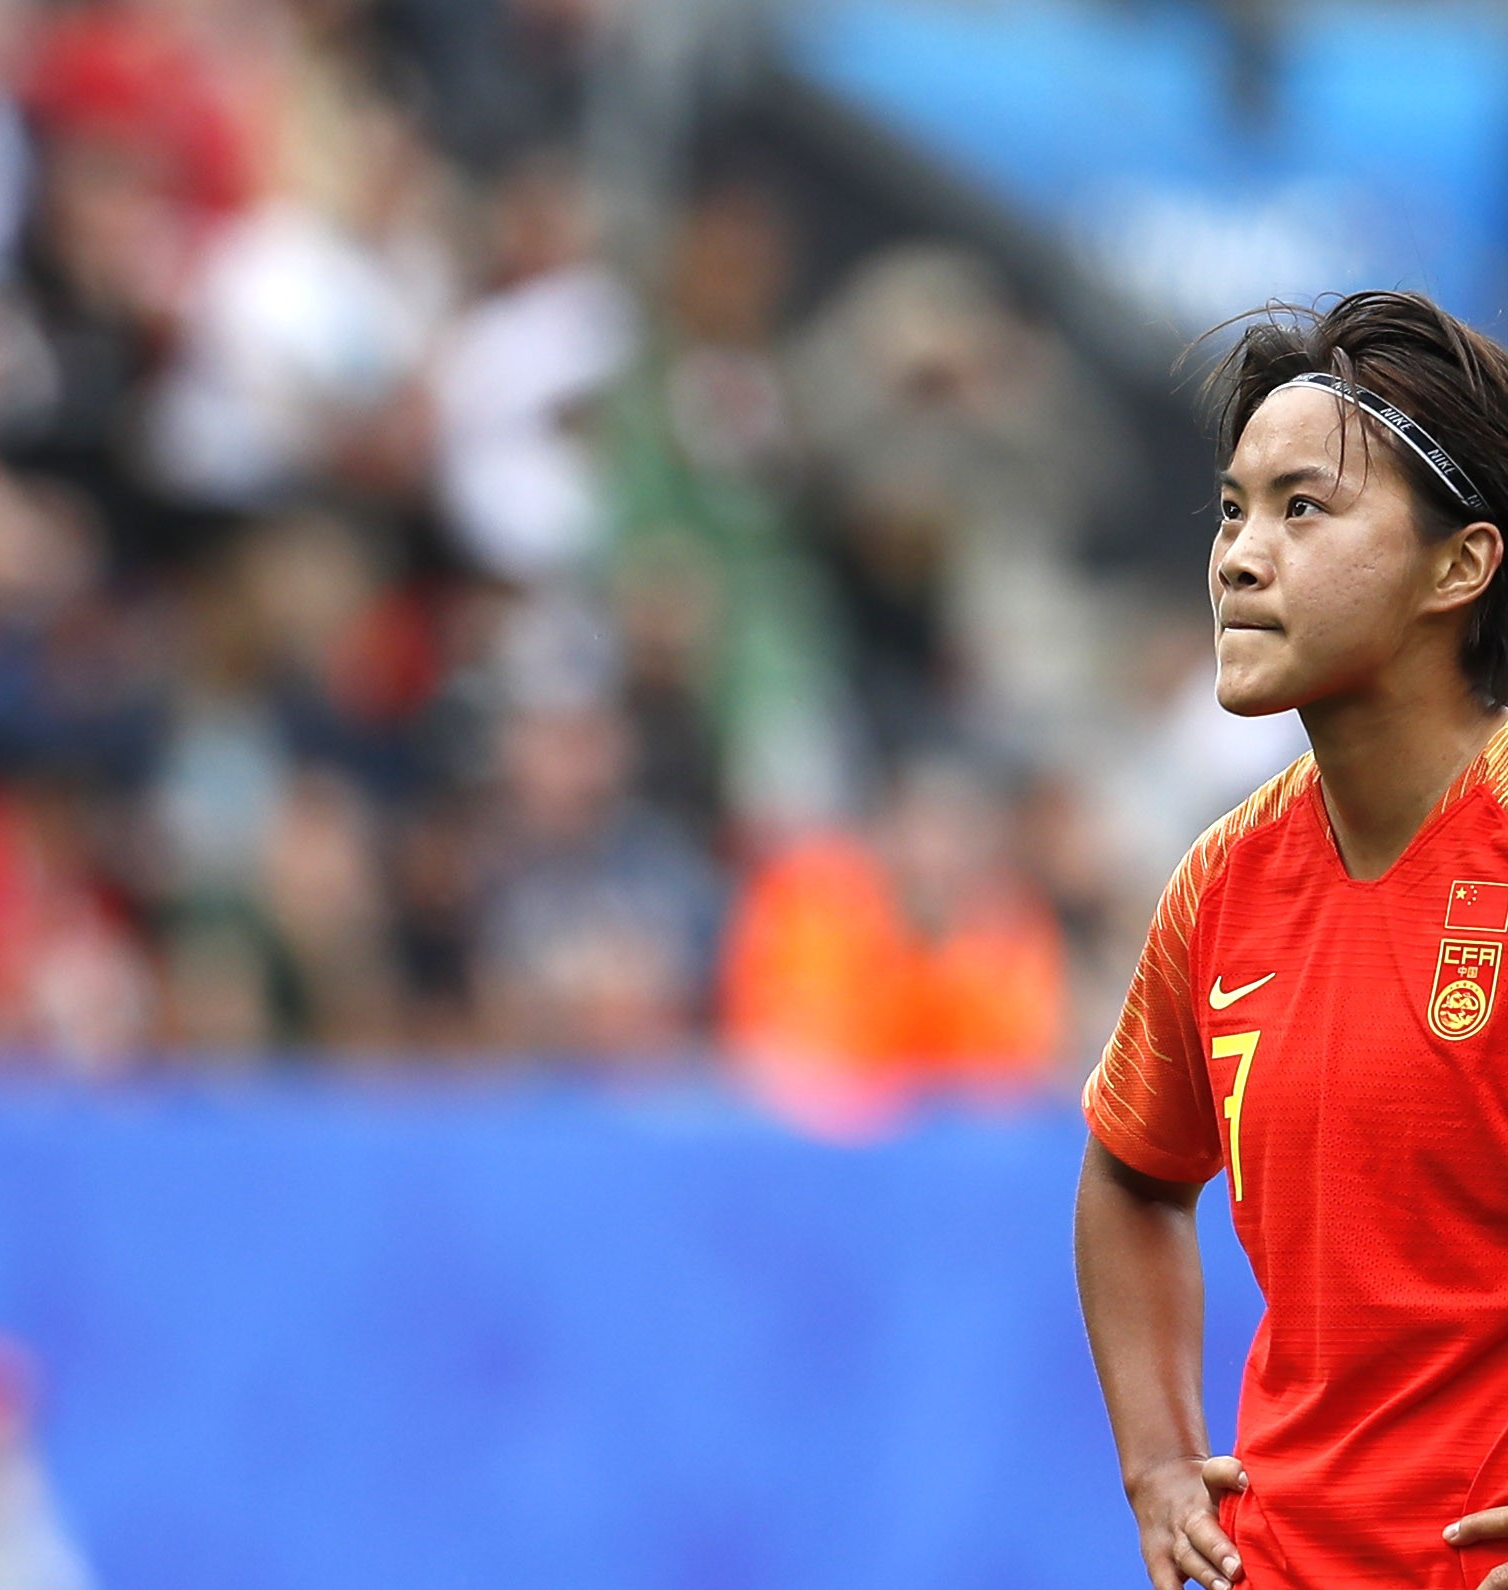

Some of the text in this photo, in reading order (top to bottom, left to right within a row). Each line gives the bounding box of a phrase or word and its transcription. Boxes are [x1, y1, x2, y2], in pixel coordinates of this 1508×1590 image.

[1380, 407, 1414, 432] NIKE
[1427, 449, 1456, 477] NIKE
[1443, 945, 1496, 967] CFA
[1211, 1029, 1261, 1202] 7
